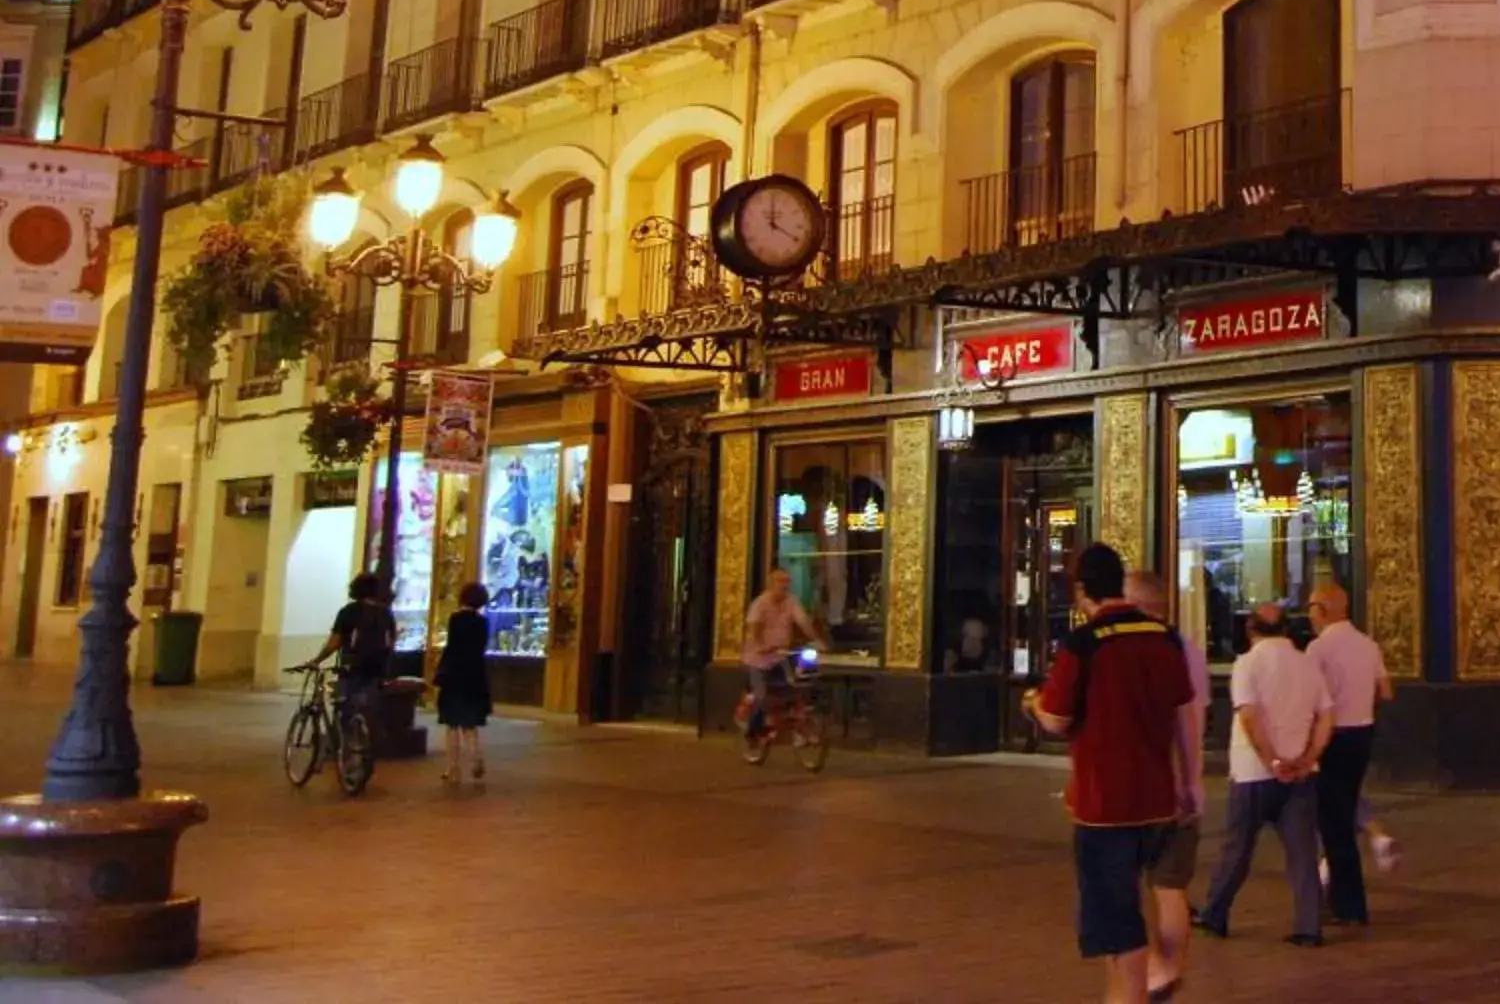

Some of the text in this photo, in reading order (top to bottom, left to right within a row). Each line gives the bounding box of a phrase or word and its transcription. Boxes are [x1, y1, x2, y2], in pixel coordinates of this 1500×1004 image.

[1182, 302, 1321, 343] ZARAGOZA
[987, 339, 1042, 370] CAFE
[800, 368, 846, 392] GRAN
